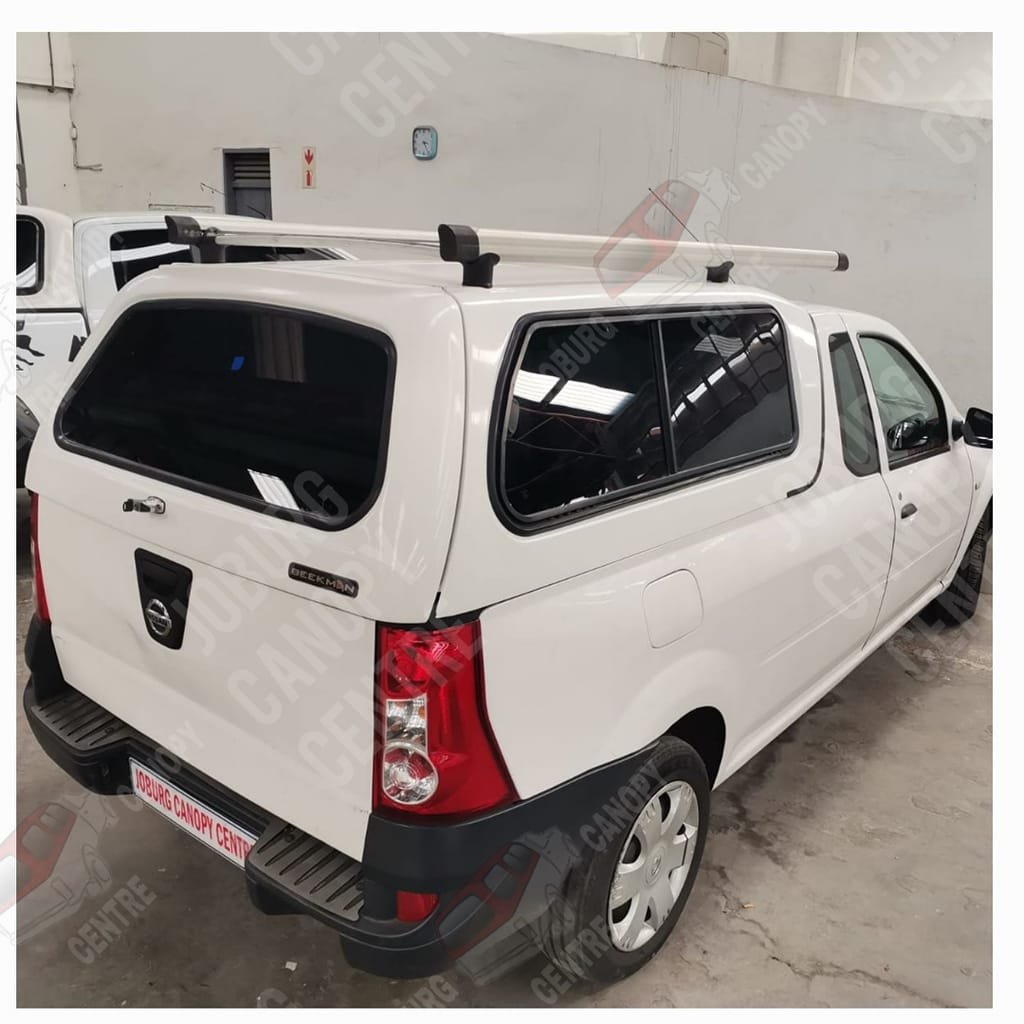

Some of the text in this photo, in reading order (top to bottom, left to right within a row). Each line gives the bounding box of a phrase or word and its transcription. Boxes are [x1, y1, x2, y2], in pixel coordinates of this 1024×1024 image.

[290, 567, 355, 595] BEEKMAN
[135, 767, 173, 811] JOBURG
[173, 794, 214, 840] CANOPY
[216, 822, 253, 860] CENTR
